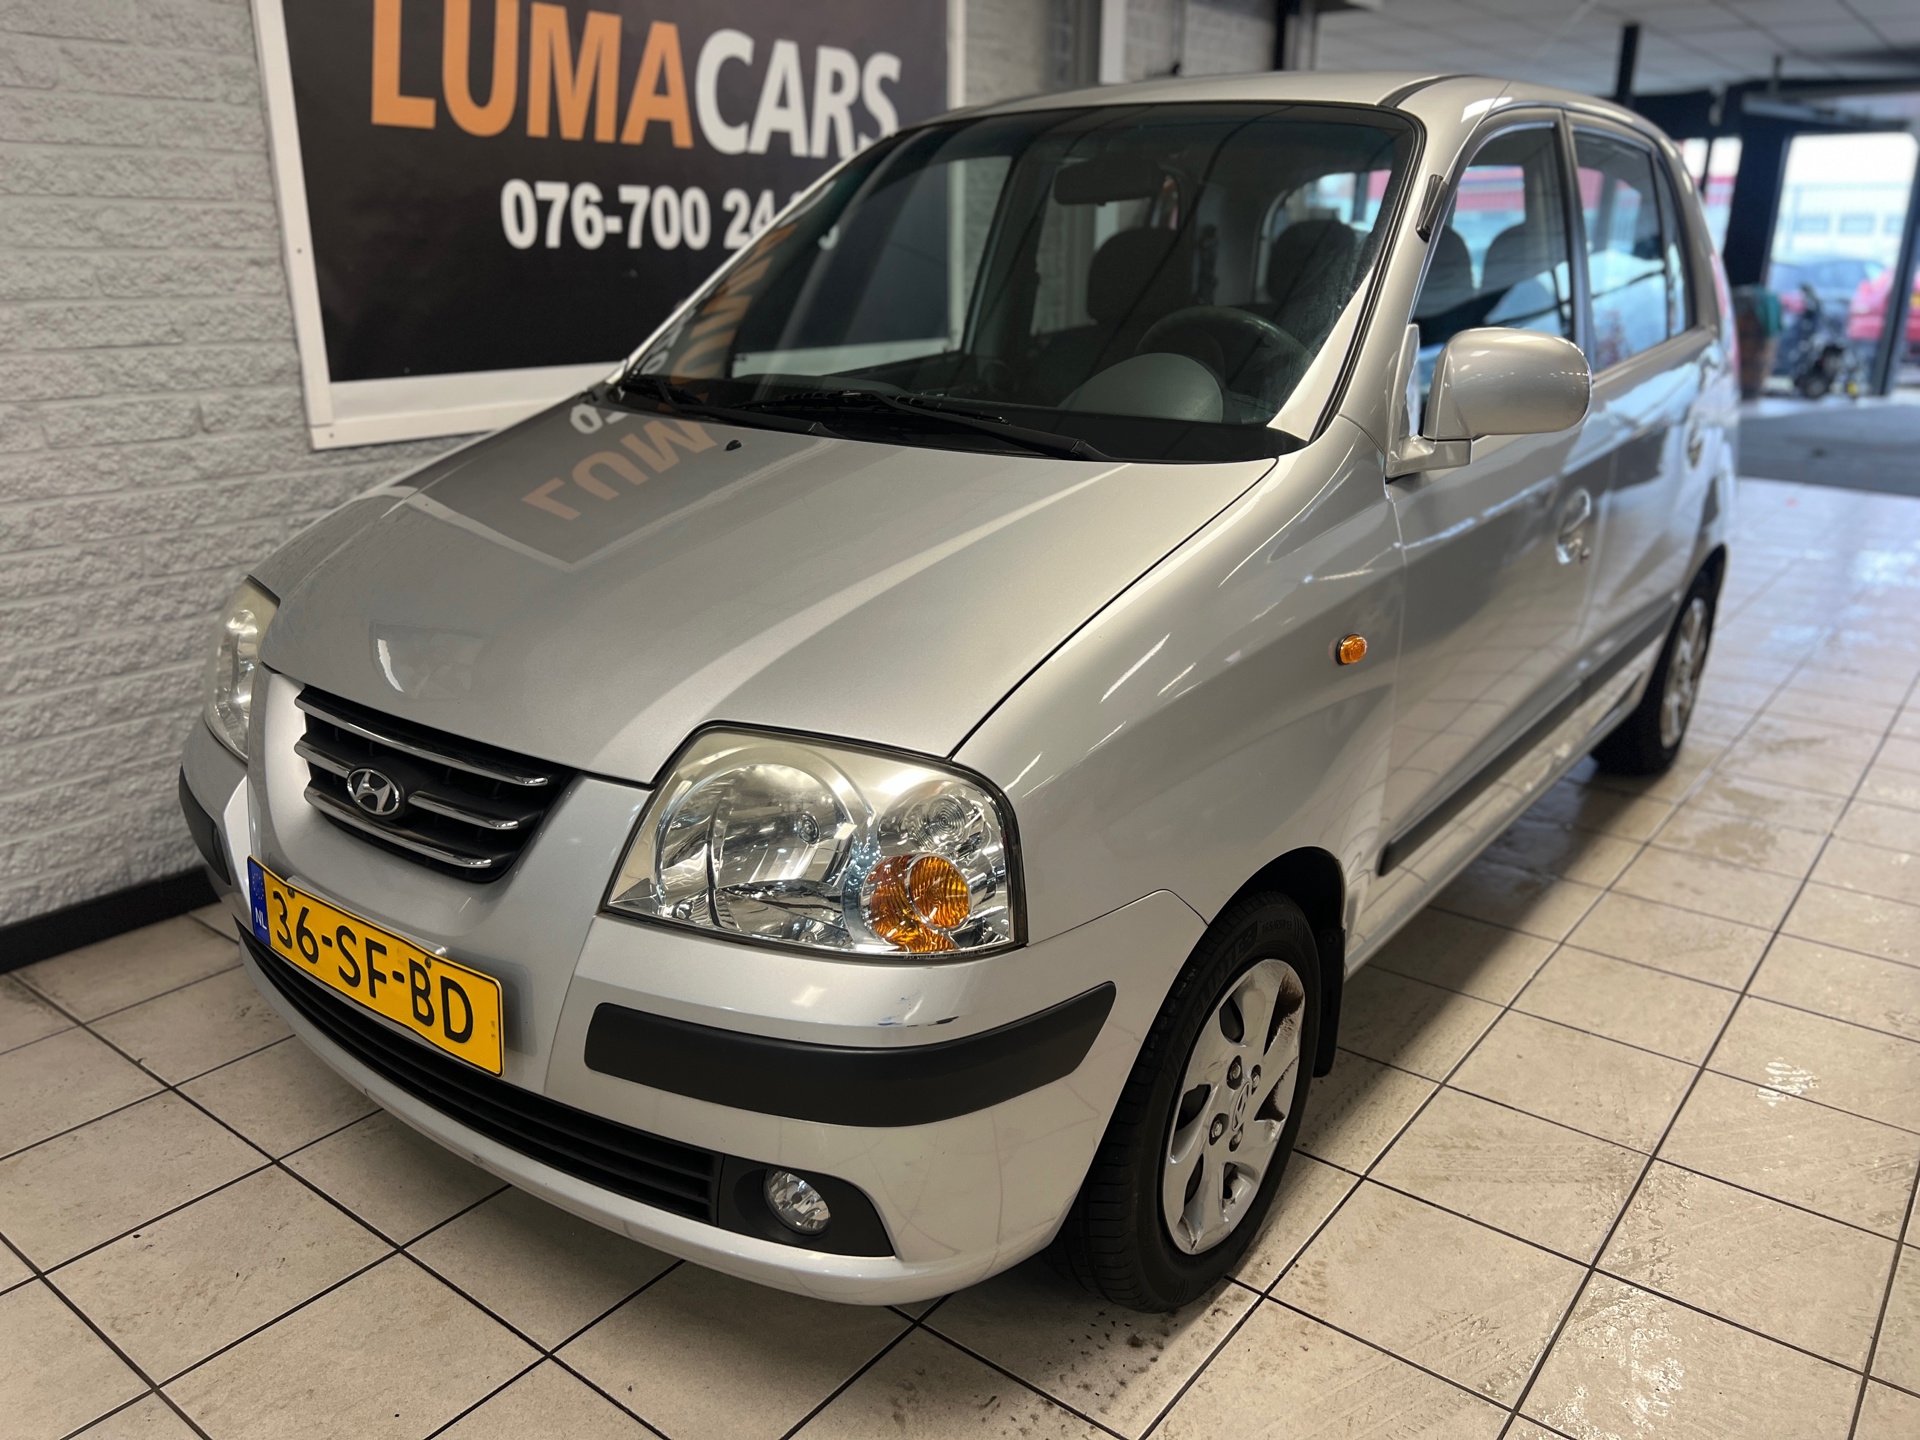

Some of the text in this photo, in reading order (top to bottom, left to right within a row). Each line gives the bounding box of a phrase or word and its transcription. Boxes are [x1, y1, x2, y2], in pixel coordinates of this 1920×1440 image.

[371, 0, 901, 158] LUMACARS
[501, 178, 711, 250] 076-700
[254, 907, 268, 931] NL
[272, 890, 474, 1044] 36-SF-BD
